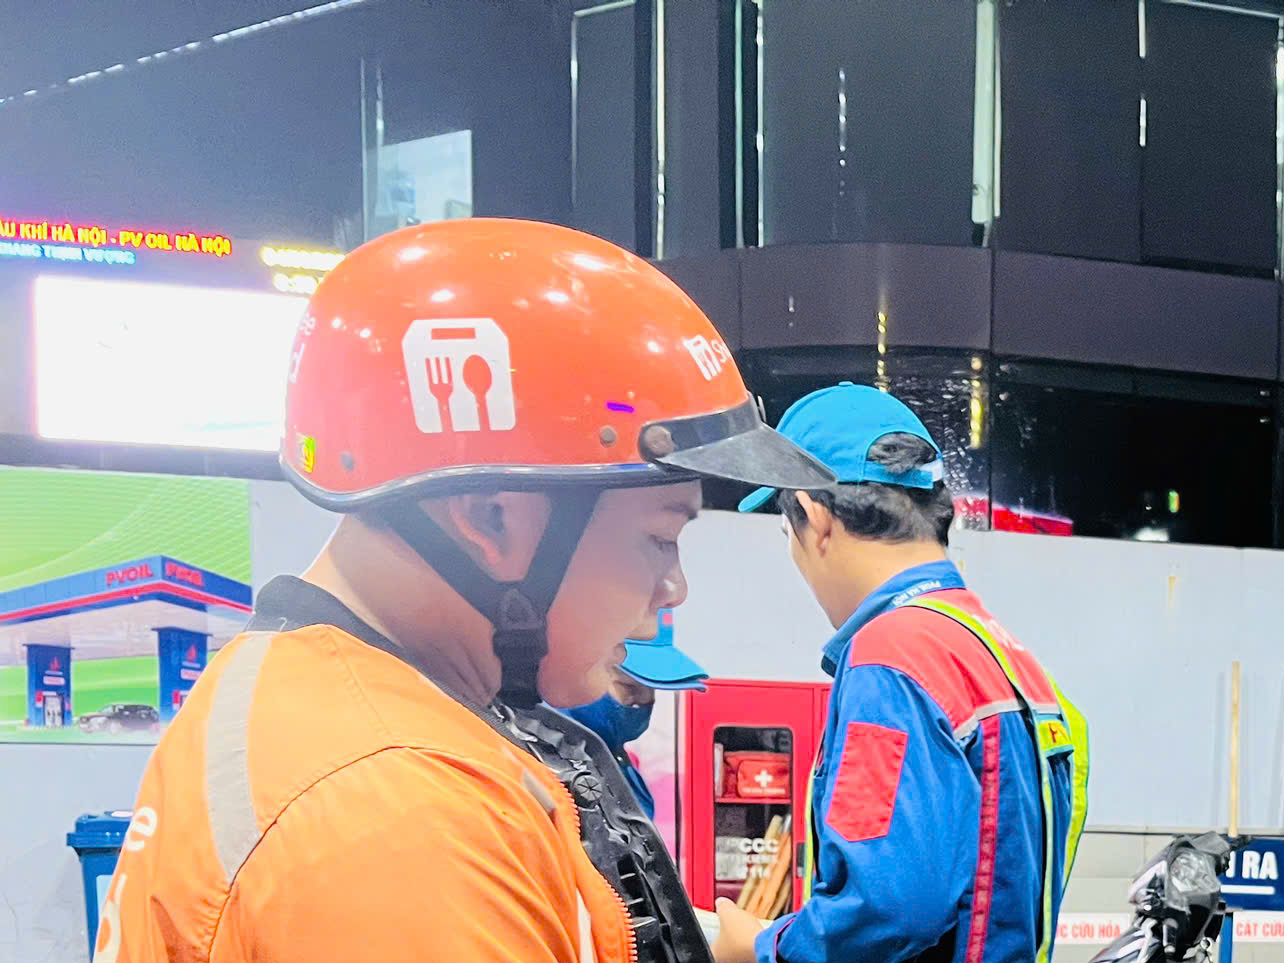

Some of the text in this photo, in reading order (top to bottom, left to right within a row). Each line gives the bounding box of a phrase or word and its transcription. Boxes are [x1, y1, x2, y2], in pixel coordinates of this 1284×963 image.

[20, 221, 48, 240] KHÍ
[51, 223, 75, 243] HÀ
[77, 226, 107, 247] NỘI
[119, 231, 143, 248] PV
[145, 233, 172, 250] OIL
[1242, 850, 1278, 880] RA
